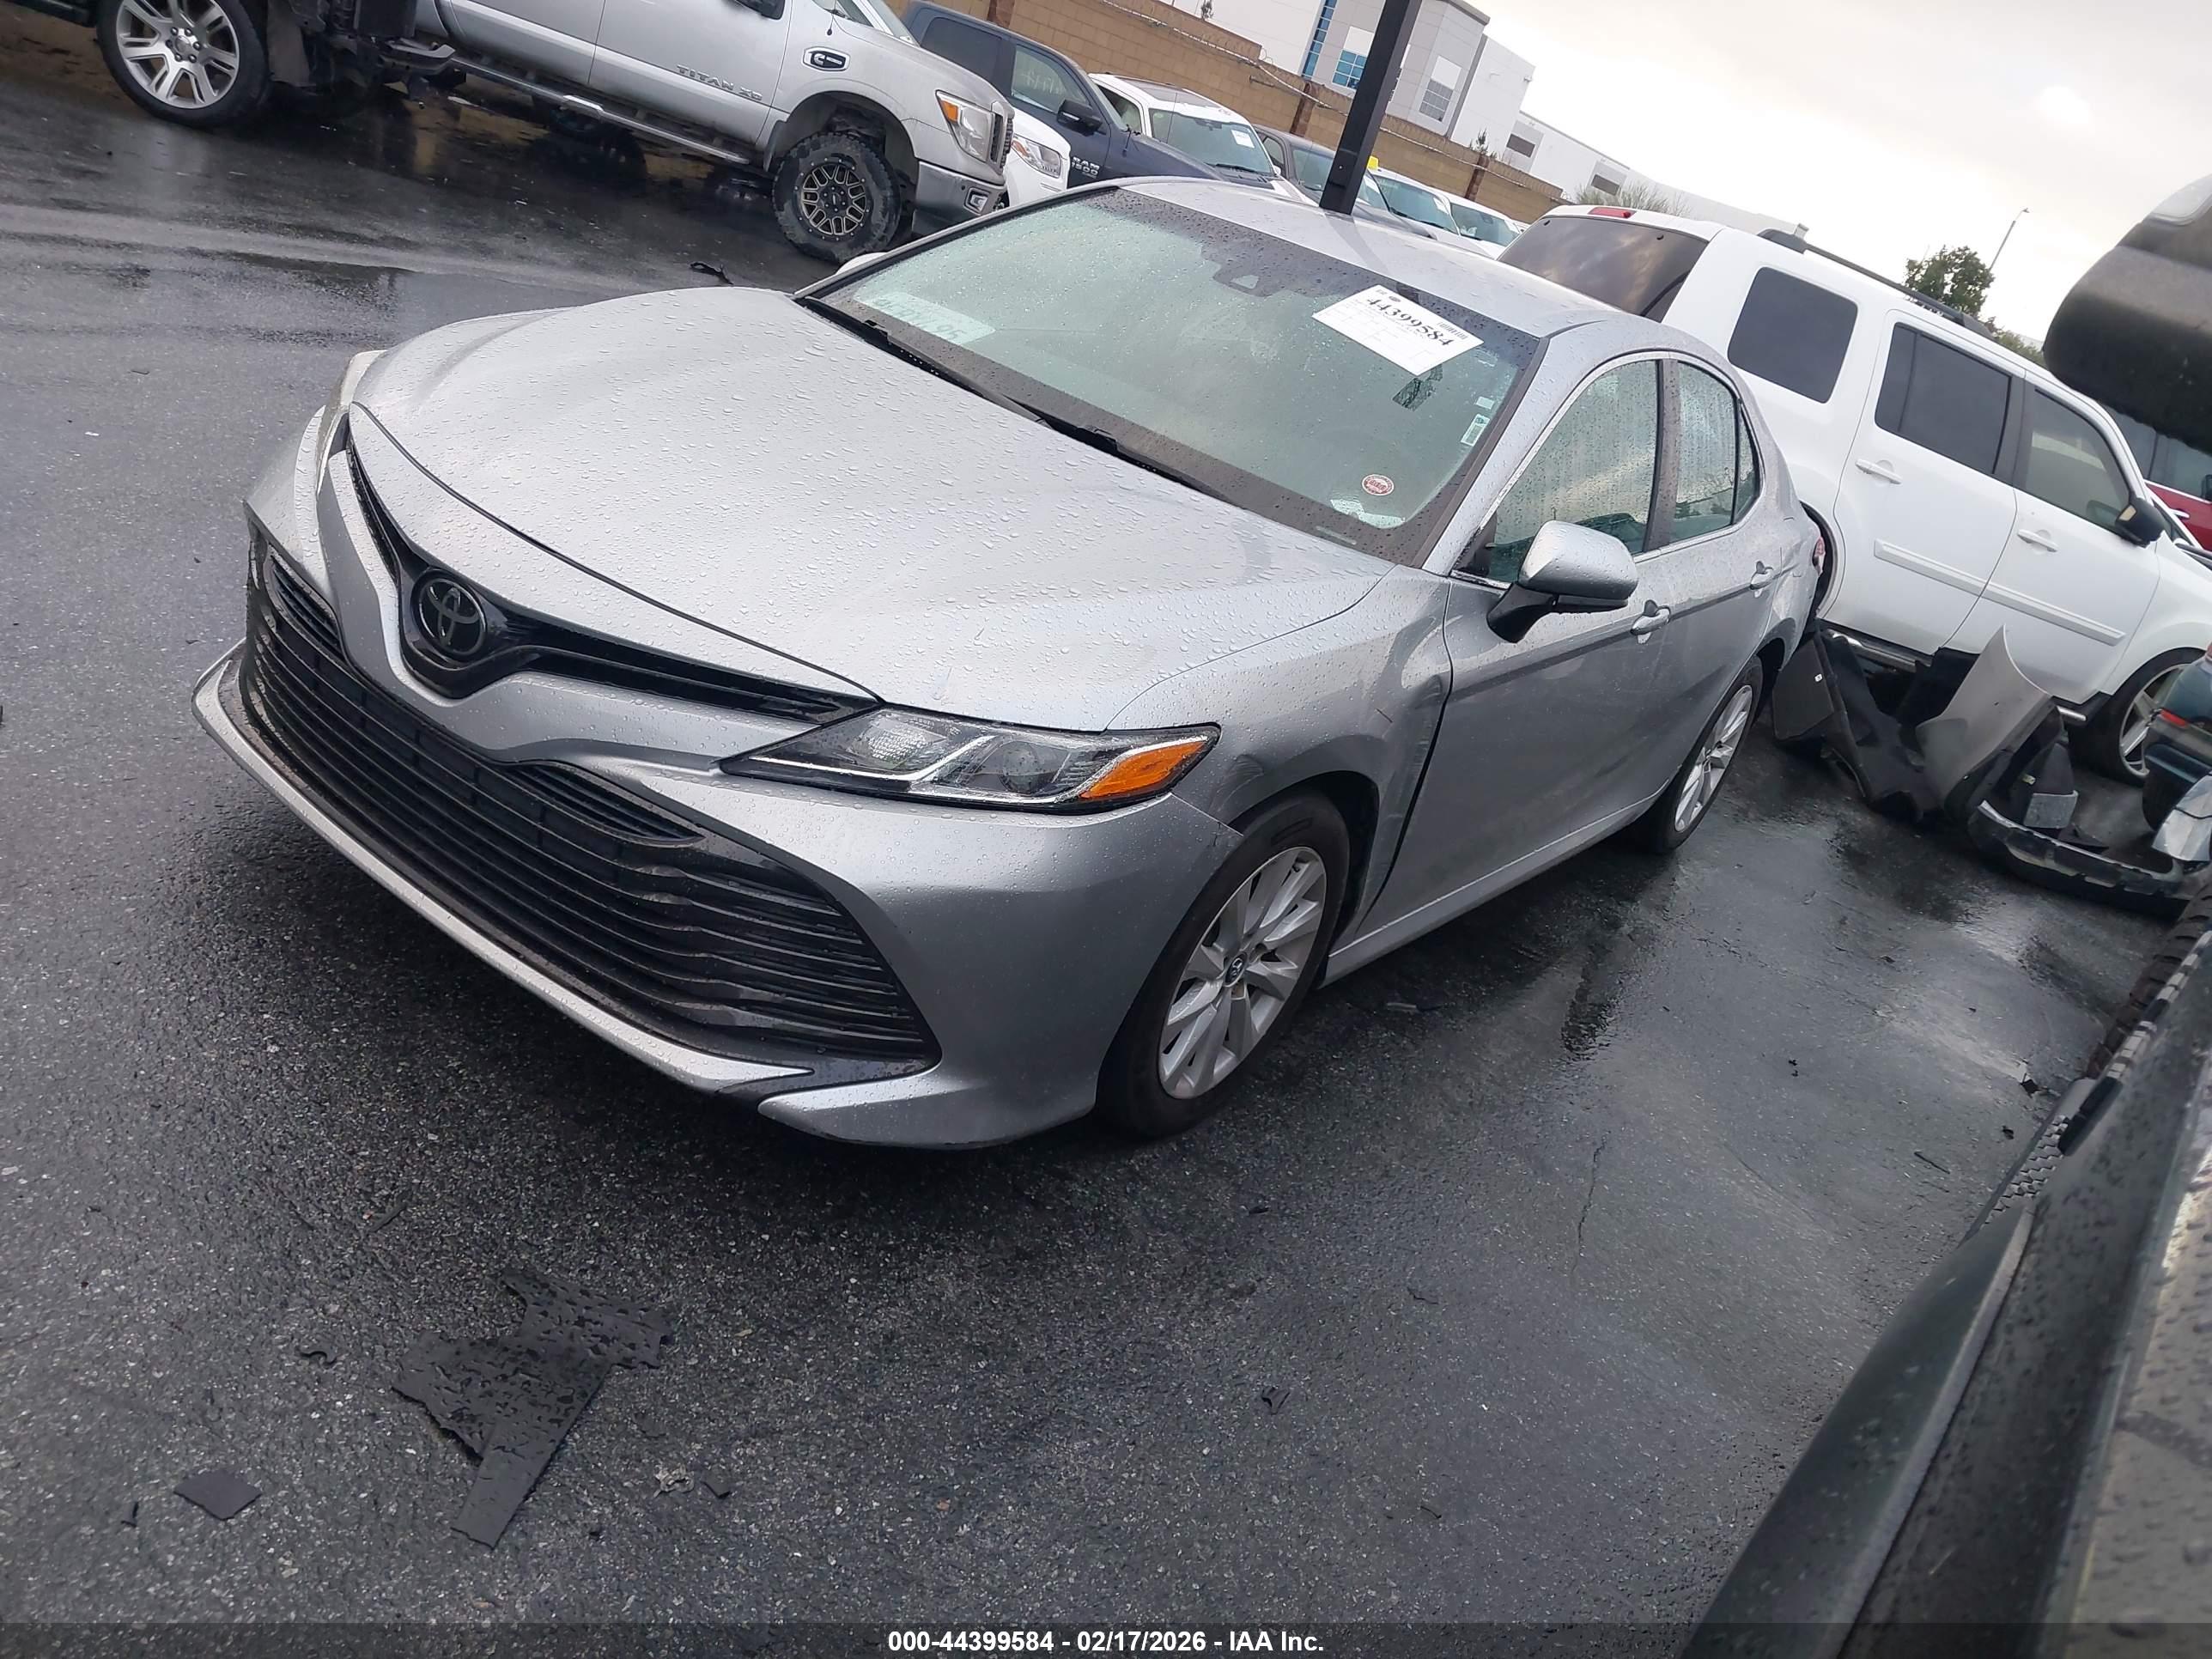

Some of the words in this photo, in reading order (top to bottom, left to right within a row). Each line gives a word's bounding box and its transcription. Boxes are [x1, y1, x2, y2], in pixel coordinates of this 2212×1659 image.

[676, 64, 734, 91] TITAN
[738, 86, 763, 101] XD
[1071, 161, 1099, 176] 1500
[1073, 156, 1100, 171] RAM
[1366, 298, 1455, 346] 44399584
